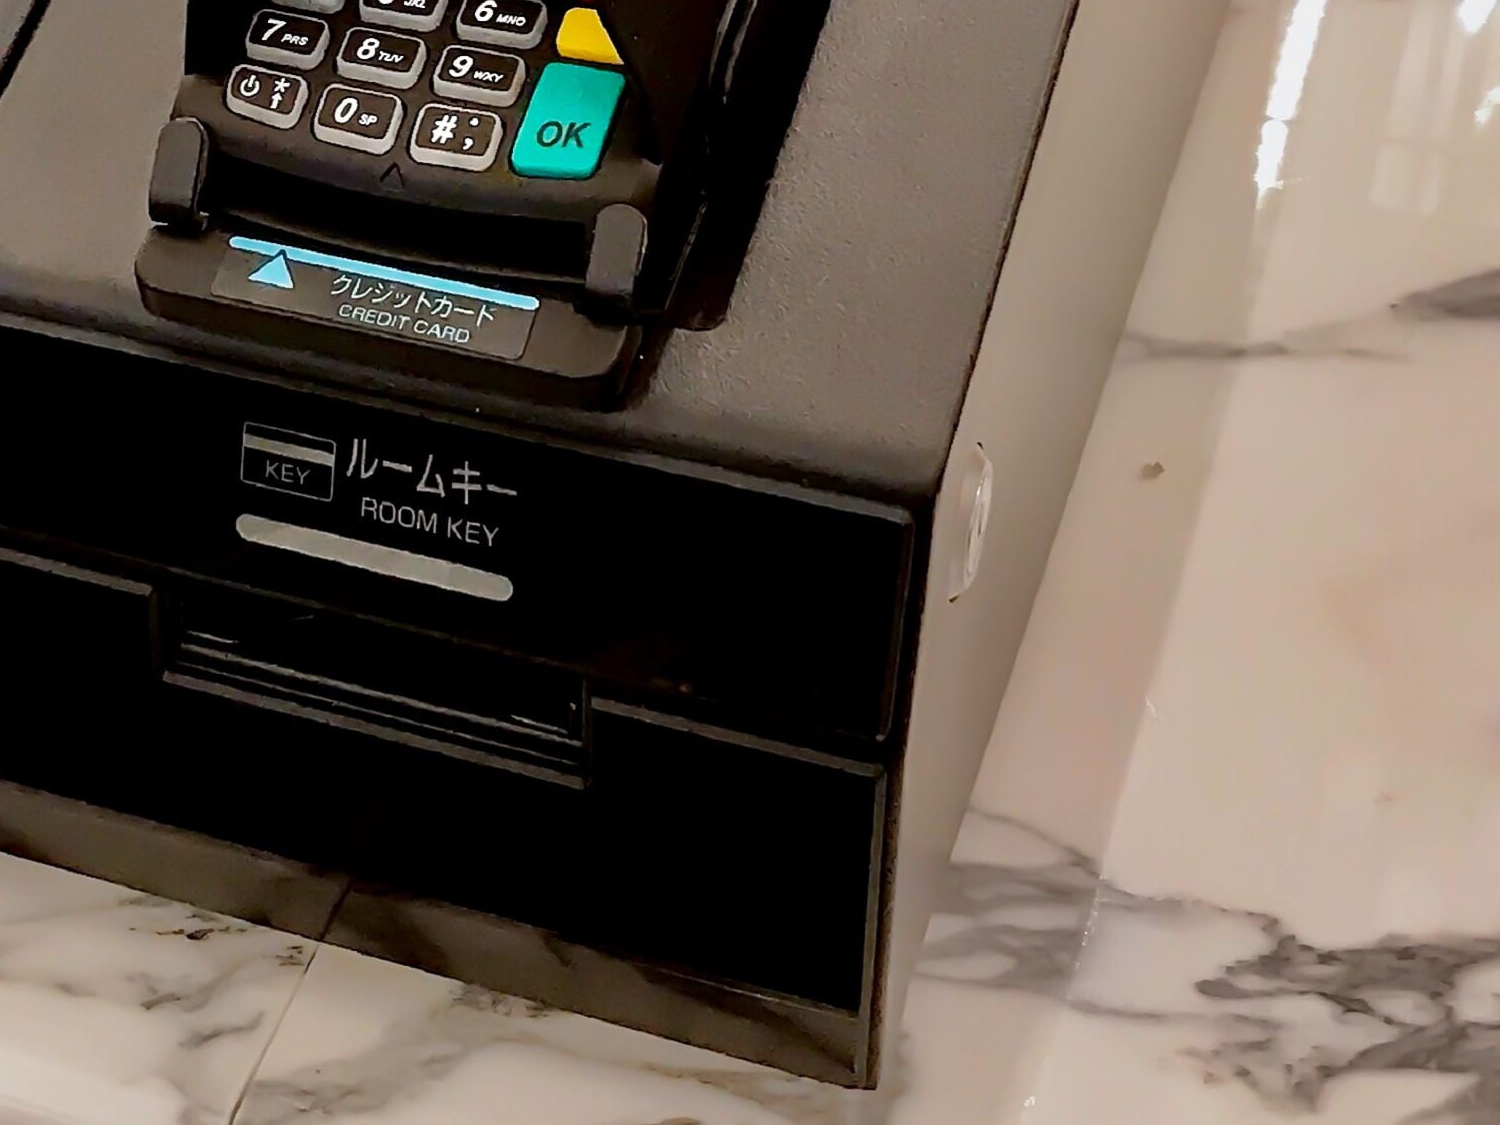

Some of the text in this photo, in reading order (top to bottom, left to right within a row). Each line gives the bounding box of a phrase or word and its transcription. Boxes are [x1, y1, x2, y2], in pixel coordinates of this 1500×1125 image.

[474, 0, 527, 27] 6 MNO
[261, 18, 309, 46] 7 PRS
[356, 37, 405, 63] 8 TUV
[448, 55, 505, 84] 9 WXY
[334, 97, 378, 126] 0 SP
[536, 120, 592, 149] OK
[329, 274, 498, 328] クレジットカード
[338, 303, 471, 344] CREDIT CARD
[264, 459, 312, 486] KEY
[345, 437, 518, 506] ルームキー
[360, 496, 500, 548] ROOM KEY
